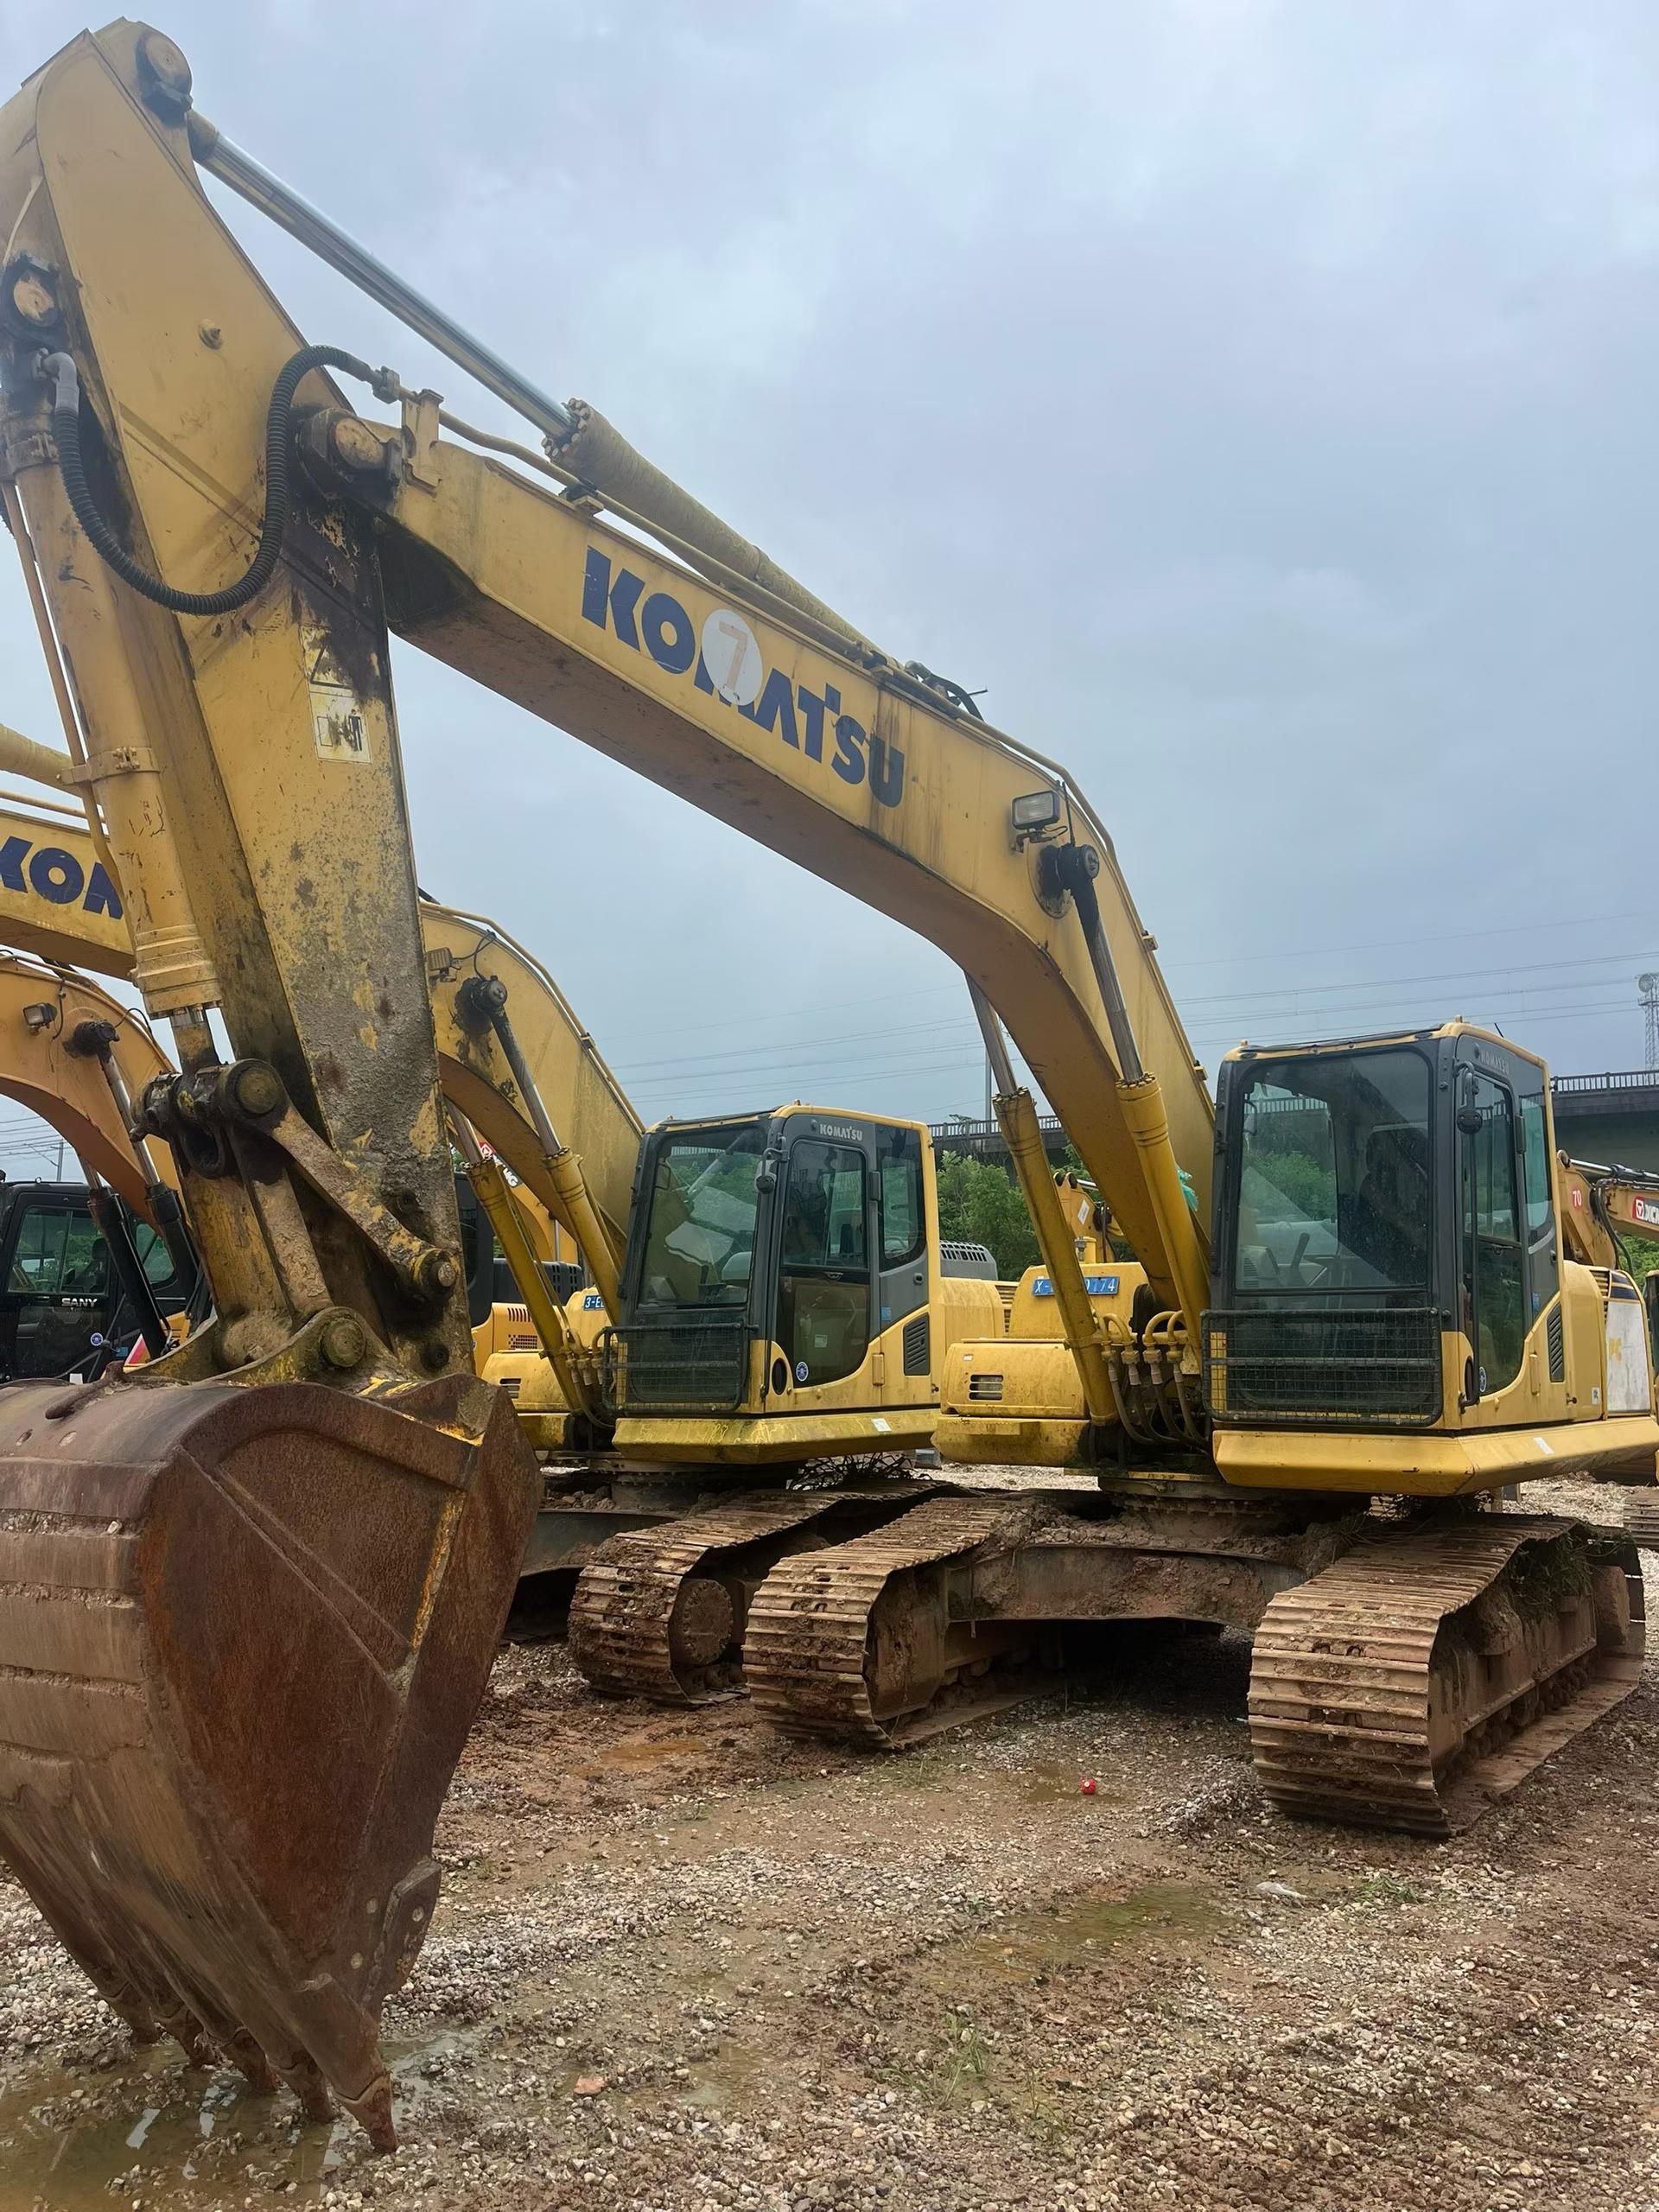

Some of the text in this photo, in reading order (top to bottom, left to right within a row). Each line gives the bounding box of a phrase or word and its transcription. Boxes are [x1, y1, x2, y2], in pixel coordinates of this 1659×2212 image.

[718, 620, 748, 690] 7
[582, 545, 905, 808] KOATSU
[820, 1123, 862, 1141] KOMATSU
[1573, 1189, 1582, 1207] 70
[61, 1297, 98, 1307] SANY
